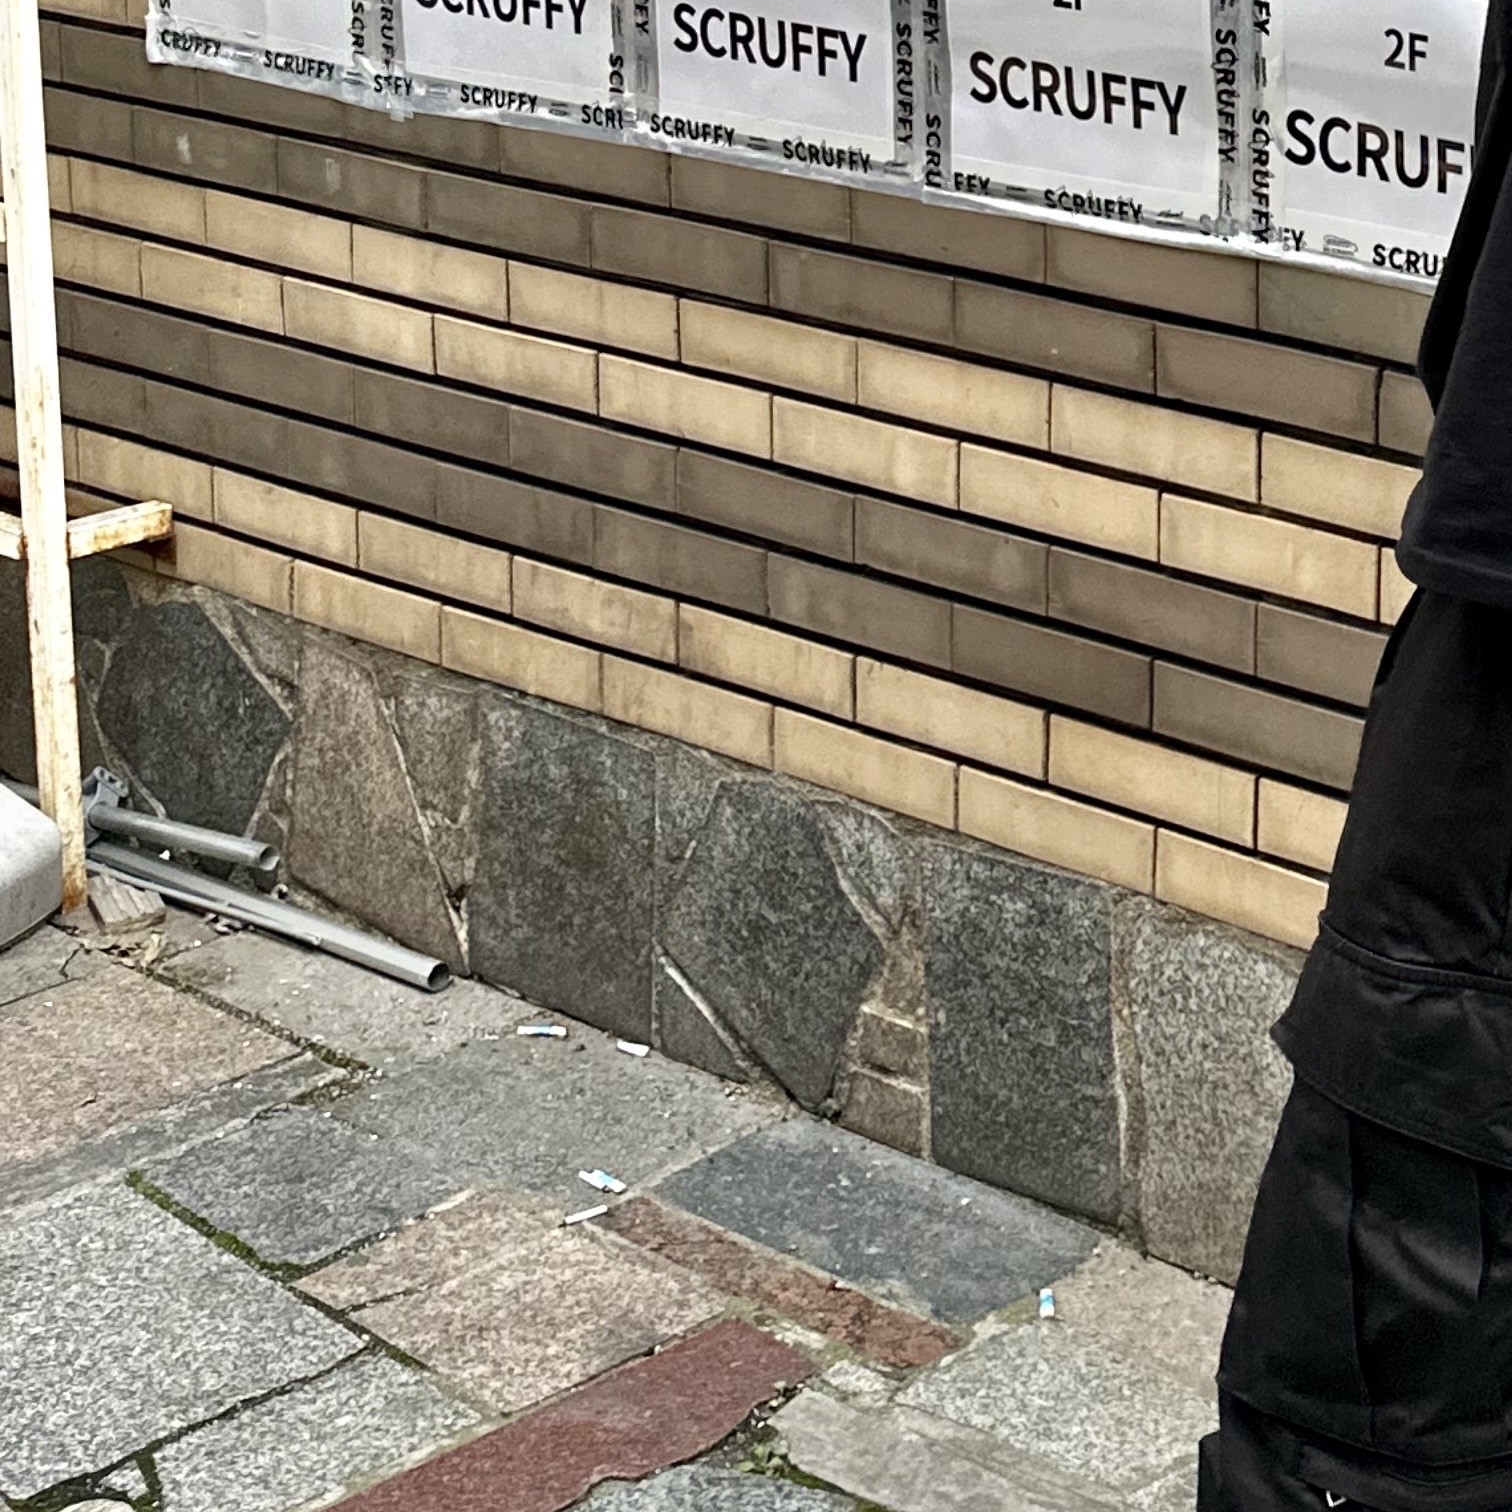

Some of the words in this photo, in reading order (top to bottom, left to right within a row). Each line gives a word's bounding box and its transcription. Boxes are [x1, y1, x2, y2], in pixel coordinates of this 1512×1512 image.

[674, 3, 866, 82] SCRUFFY
[1385, 29, 1428, 71] 2F
[970, 51, 1187, 135] SCRUFFY
[1285, 109, 1475, 194] SCRUF
